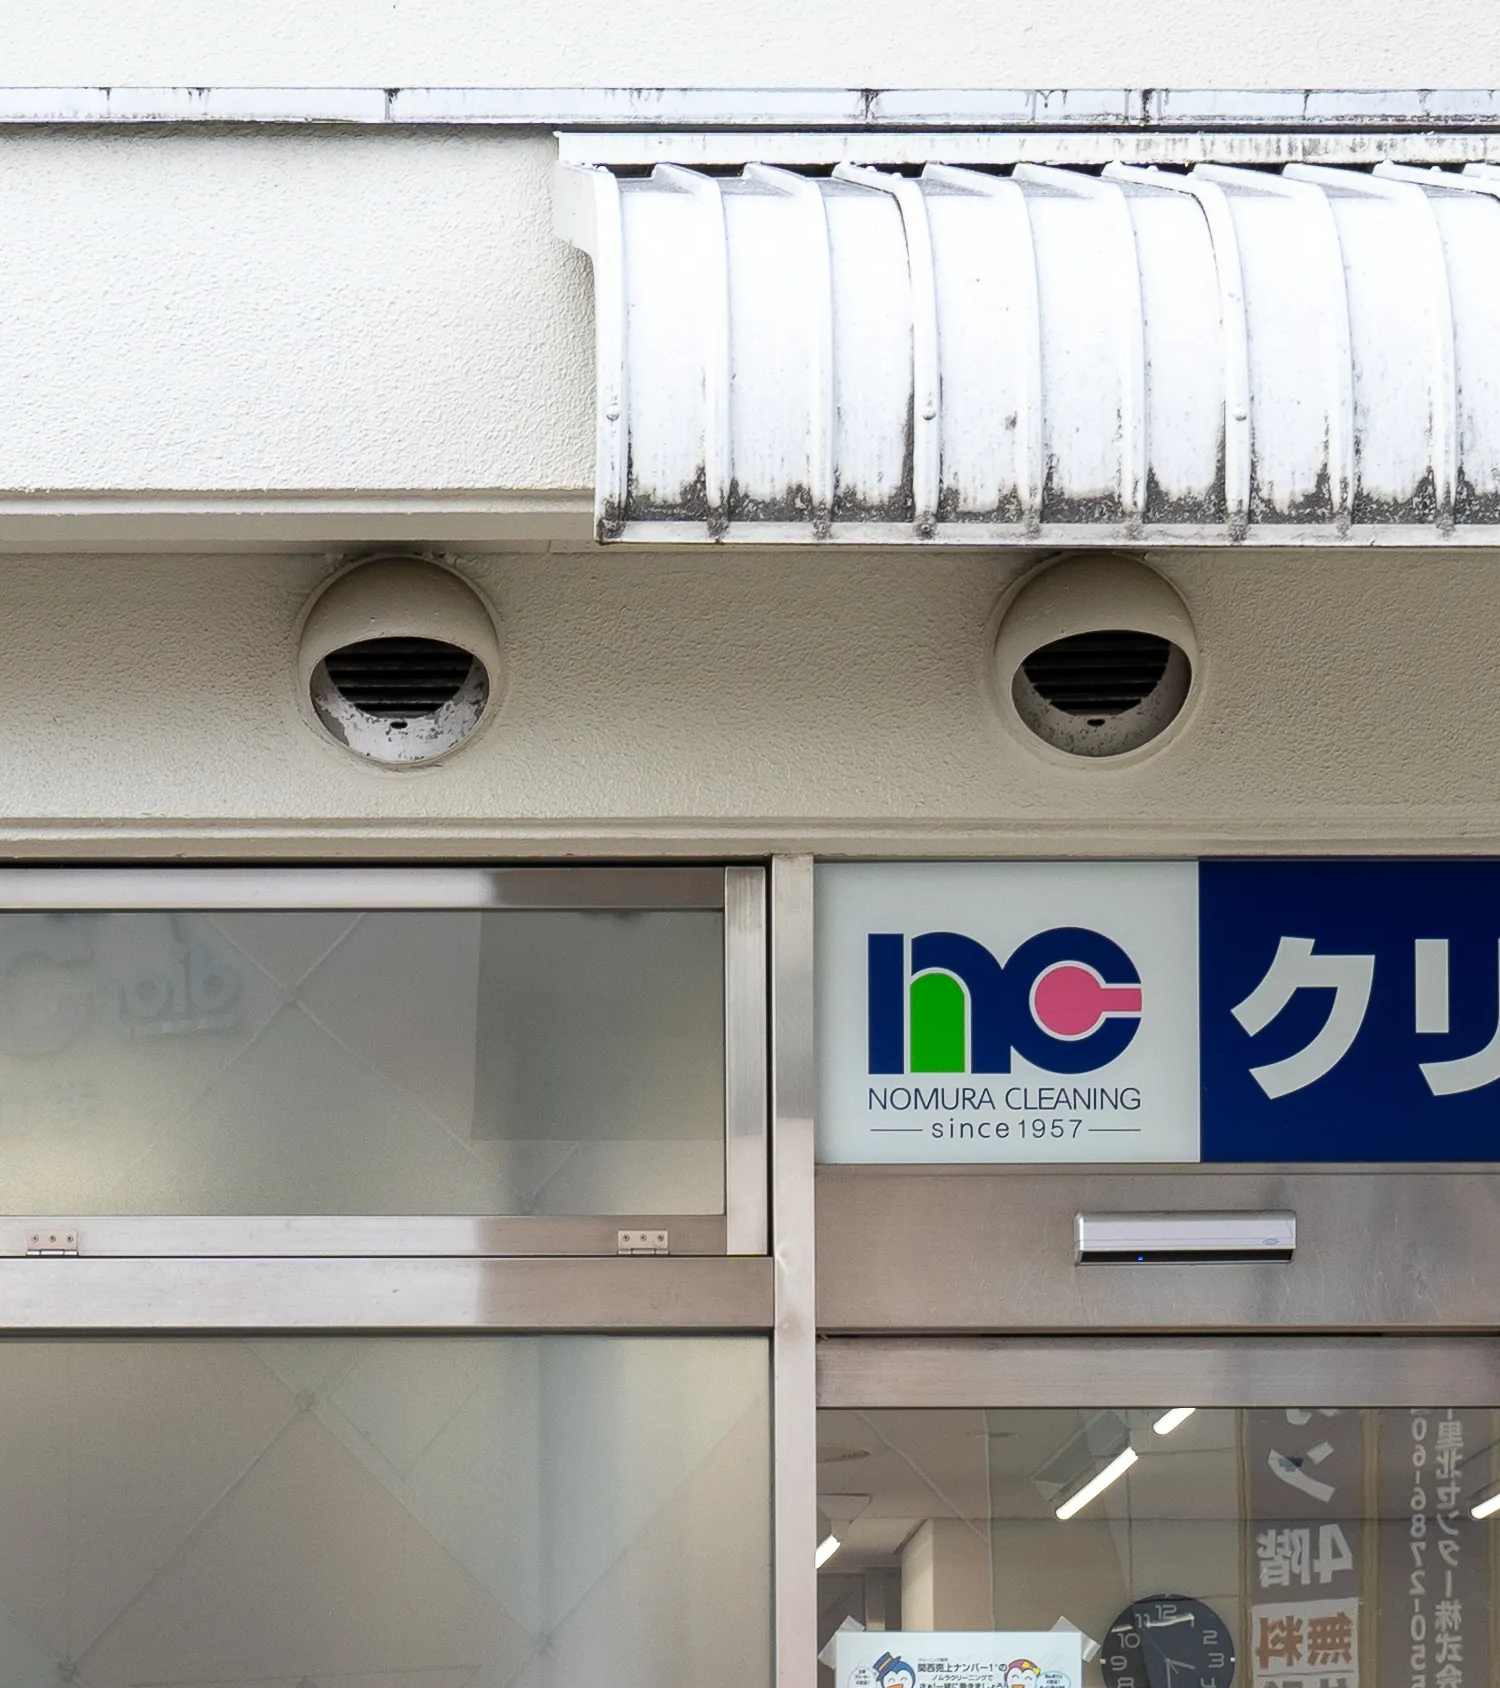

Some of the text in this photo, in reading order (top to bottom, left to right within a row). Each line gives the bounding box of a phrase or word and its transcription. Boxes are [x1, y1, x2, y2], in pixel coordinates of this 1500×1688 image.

[868, 926, 1142, 1075] nc
[868, 1087, 1142, 1111] NOMURA CLEANING
[1155, 1604, 1177, 1620] 12
[1117, 1632, 1141, 1649] 10
[1203, 1630, 1218, 1645] 2
[1110, 1655, 1128, 1671] 9
[1208, 1652, 1225, 1668] 3
